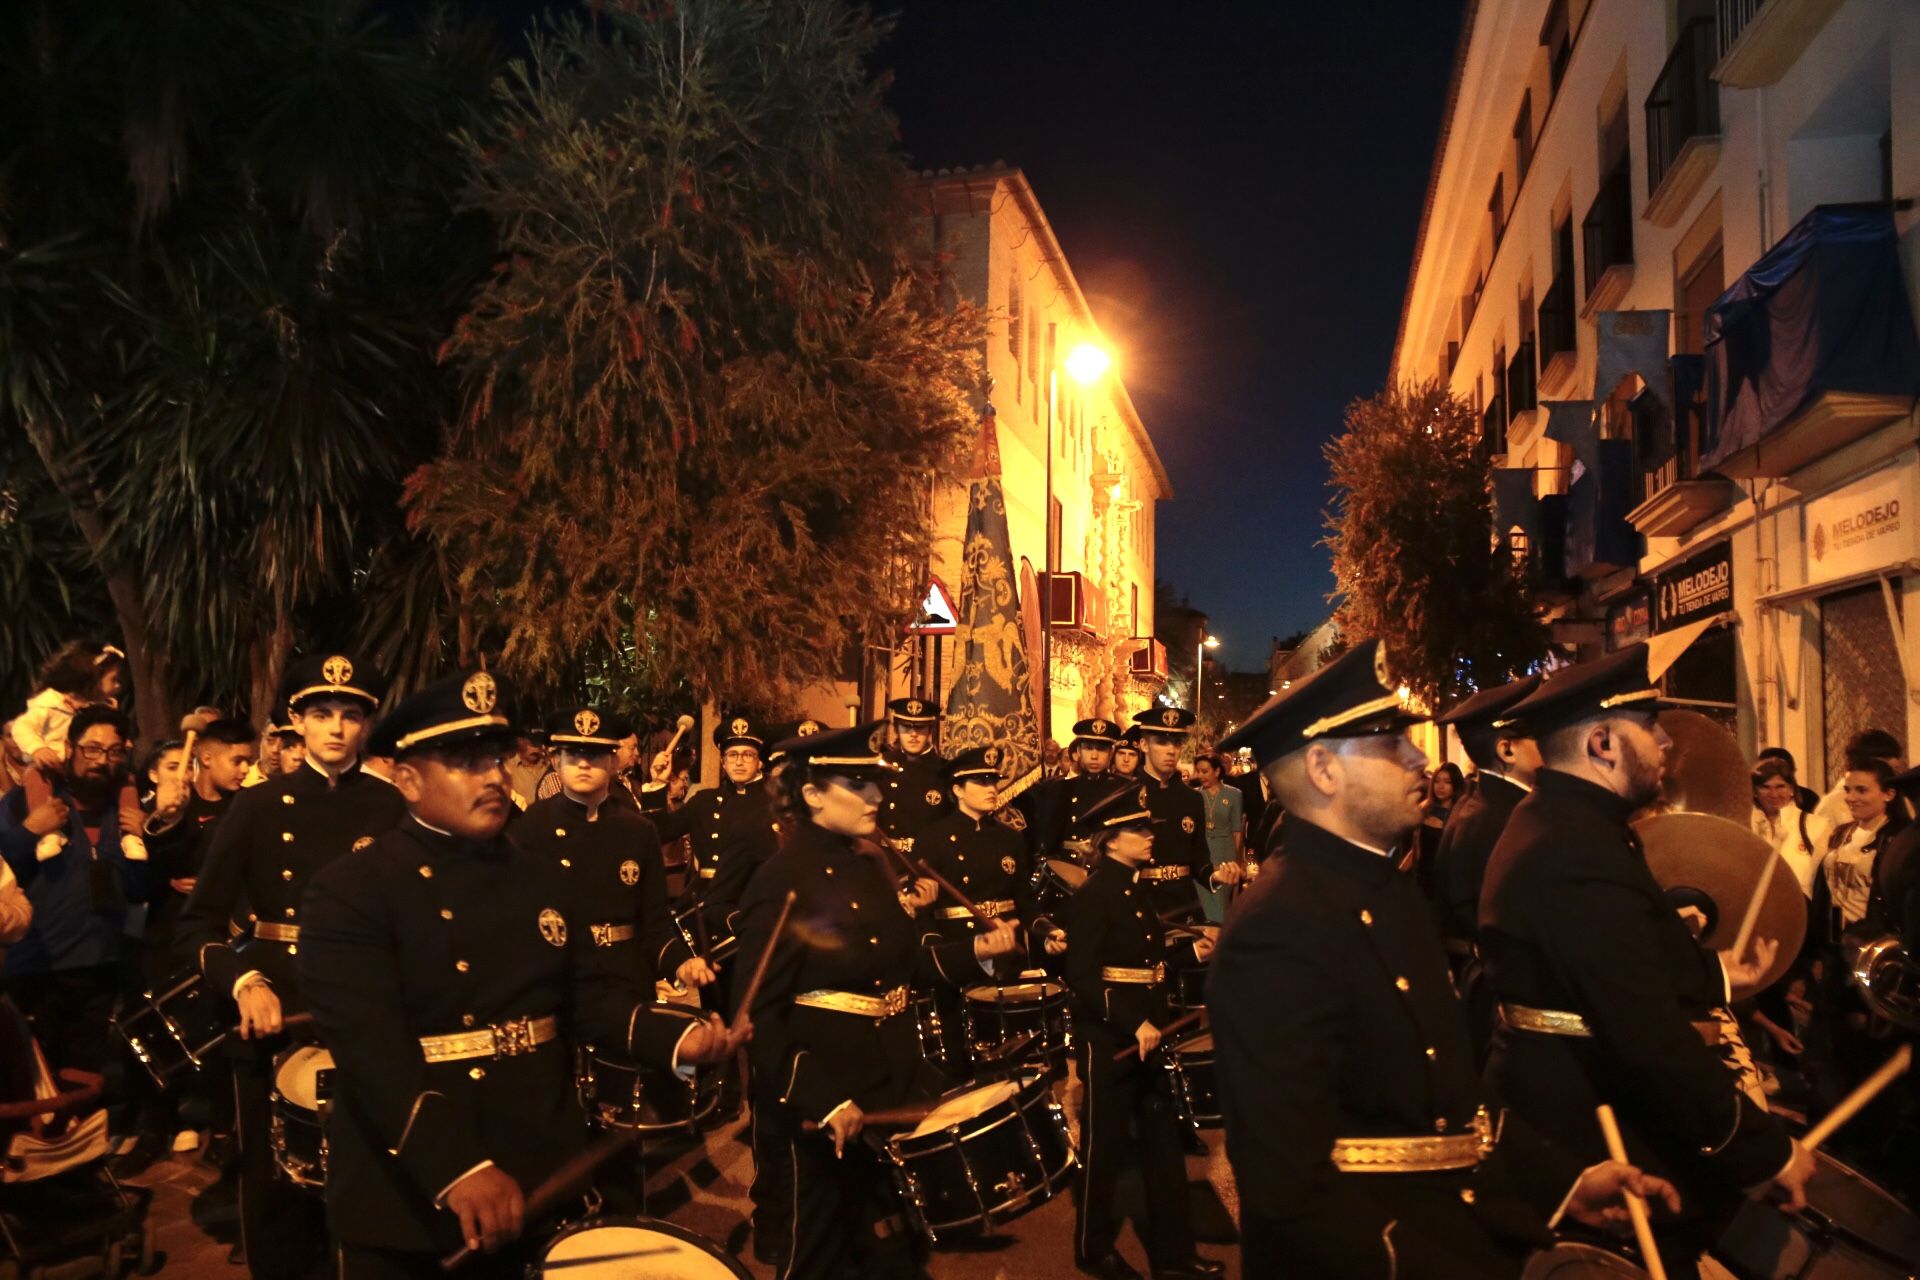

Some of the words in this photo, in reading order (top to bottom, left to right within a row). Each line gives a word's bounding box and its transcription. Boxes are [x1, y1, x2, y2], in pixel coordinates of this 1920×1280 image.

[1832, 499, 1900, 539] MELODEJO
[1678, 560, 1729, 599] MELODEJO
[1679, 604, 1686, 615] TU
[1686, 597, 1702, 612] TIENDA
[1703, 594, 1711, 606] DE
